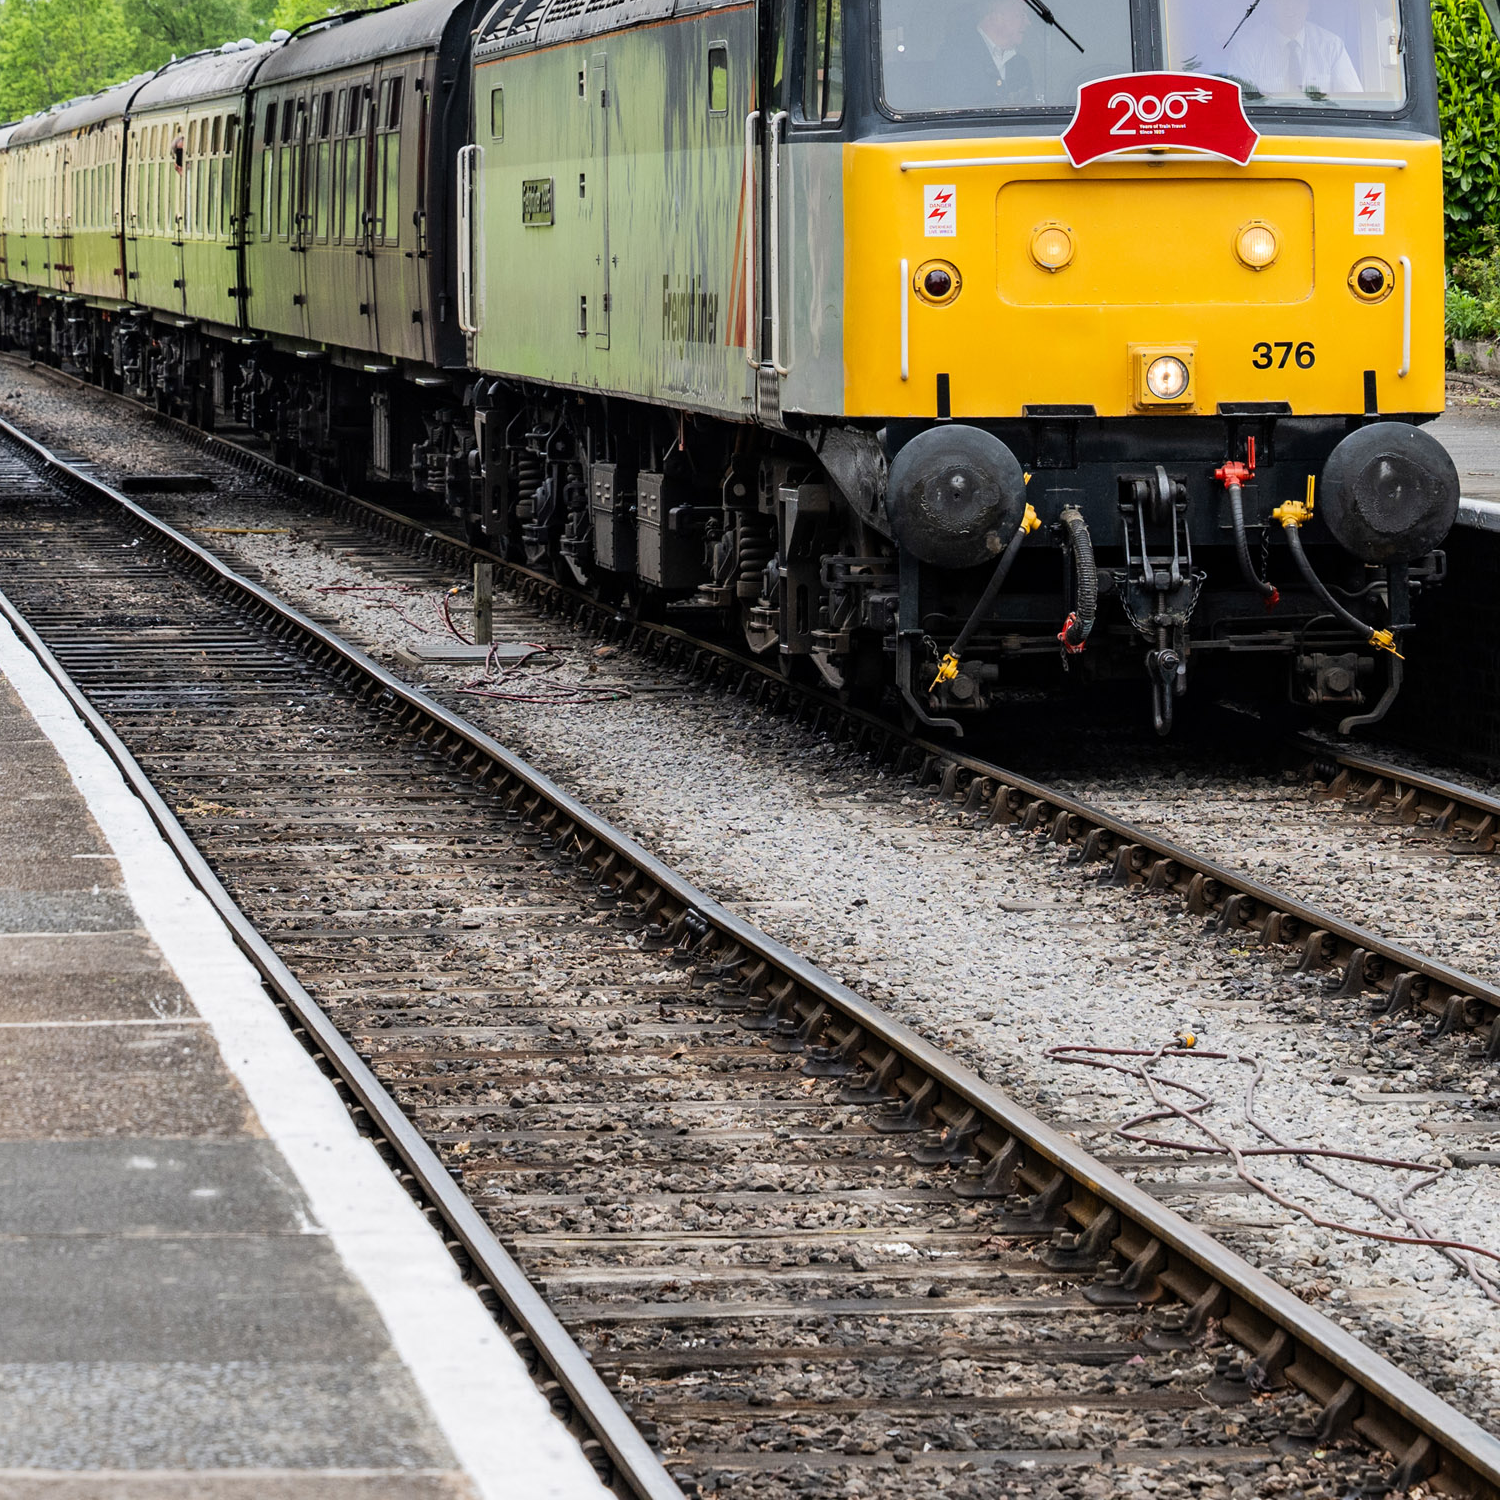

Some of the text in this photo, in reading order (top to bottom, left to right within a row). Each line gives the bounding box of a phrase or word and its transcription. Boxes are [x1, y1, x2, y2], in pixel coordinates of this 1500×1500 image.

[1108, 91, 1189, 135] 200
[662, 274, 718, 361] Freightliner
[1252, 341, 1316, 370] 376
